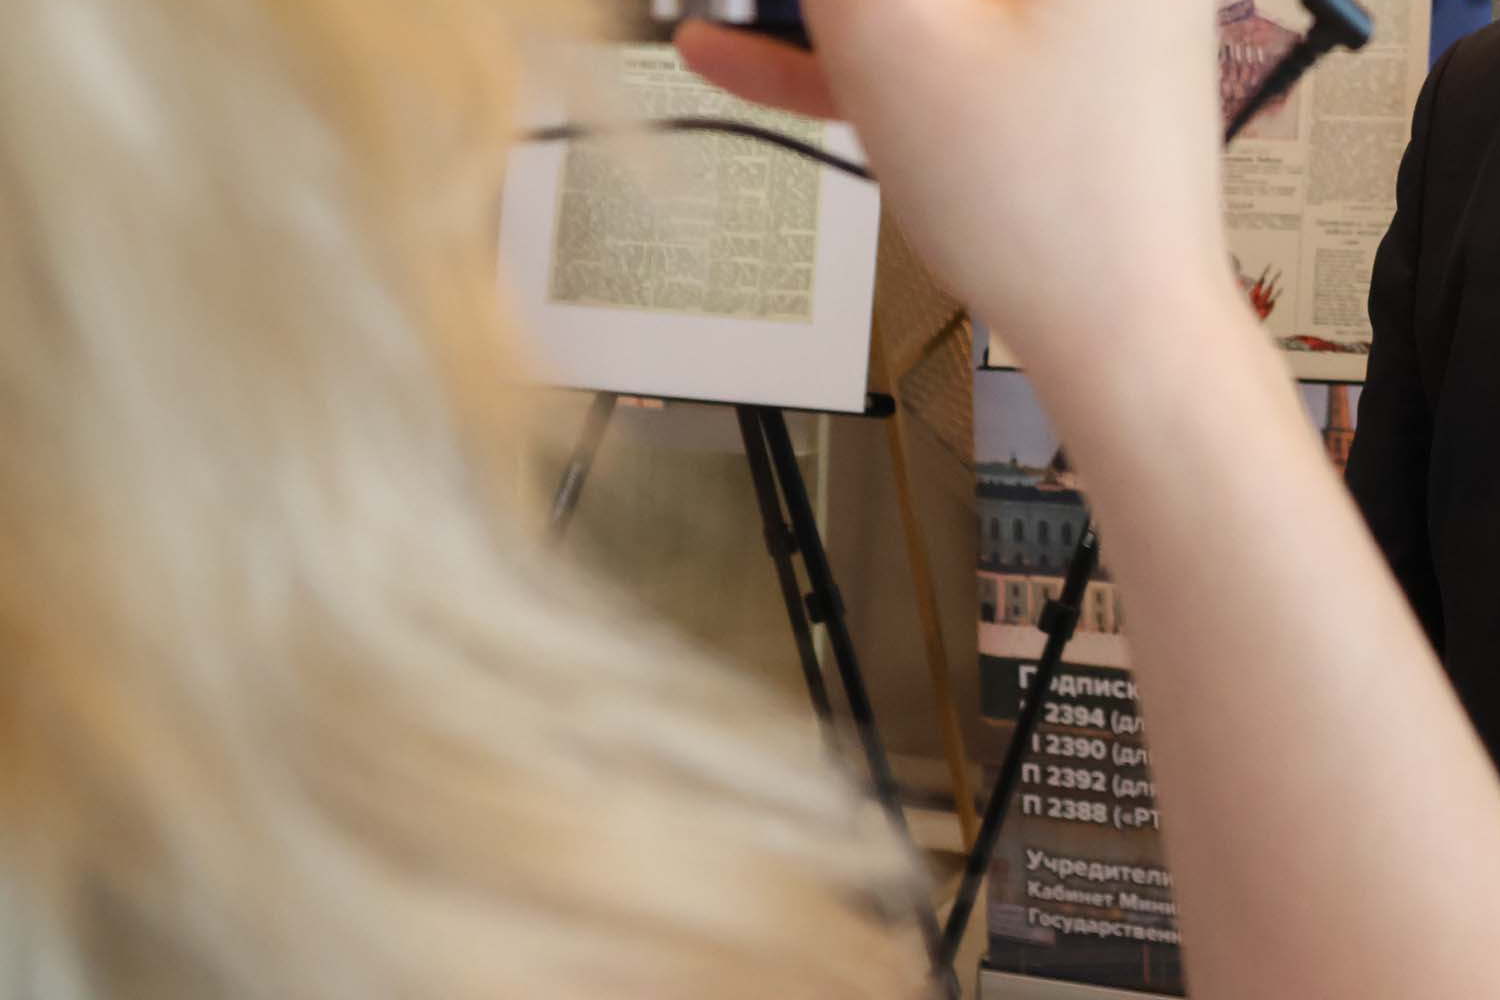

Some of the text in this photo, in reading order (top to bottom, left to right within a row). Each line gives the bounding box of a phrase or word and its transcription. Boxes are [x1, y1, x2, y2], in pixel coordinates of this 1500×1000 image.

[1044, 702, 1105, 729] 2394
[1046, 734, 1106, 761] 2390
[1111, 742, 1150, 767] (дл
[1022, 762, 1041, 784] П
[1047, 765, 1106, 793] 2392
[1022, 794, 1042, 816] П
[1047, 797, 1108, 824] 2388
[1027, 880, 1113, 907] Кабинет
